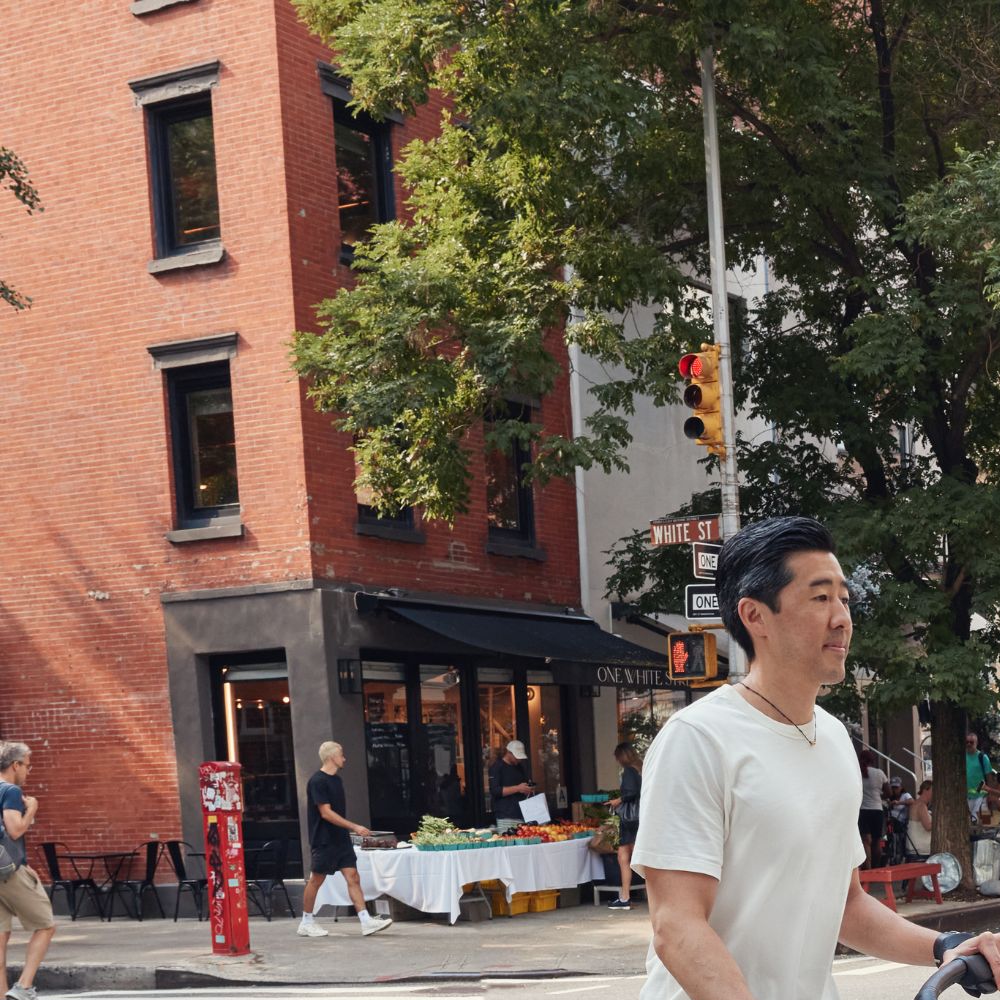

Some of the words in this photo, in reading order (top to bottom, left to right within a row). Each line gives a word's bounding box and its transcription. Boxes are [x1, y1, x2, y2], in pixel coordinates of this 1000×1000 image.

[653, 523, 690, 544] WHITE
[698, 520, 712, 540] ST
[701, 554, 716, 568] ONE
[696, 595, 719, 609] ONE
[597, 666, 623, 684] ONE
[624, 668, 661, 686] WHITE
